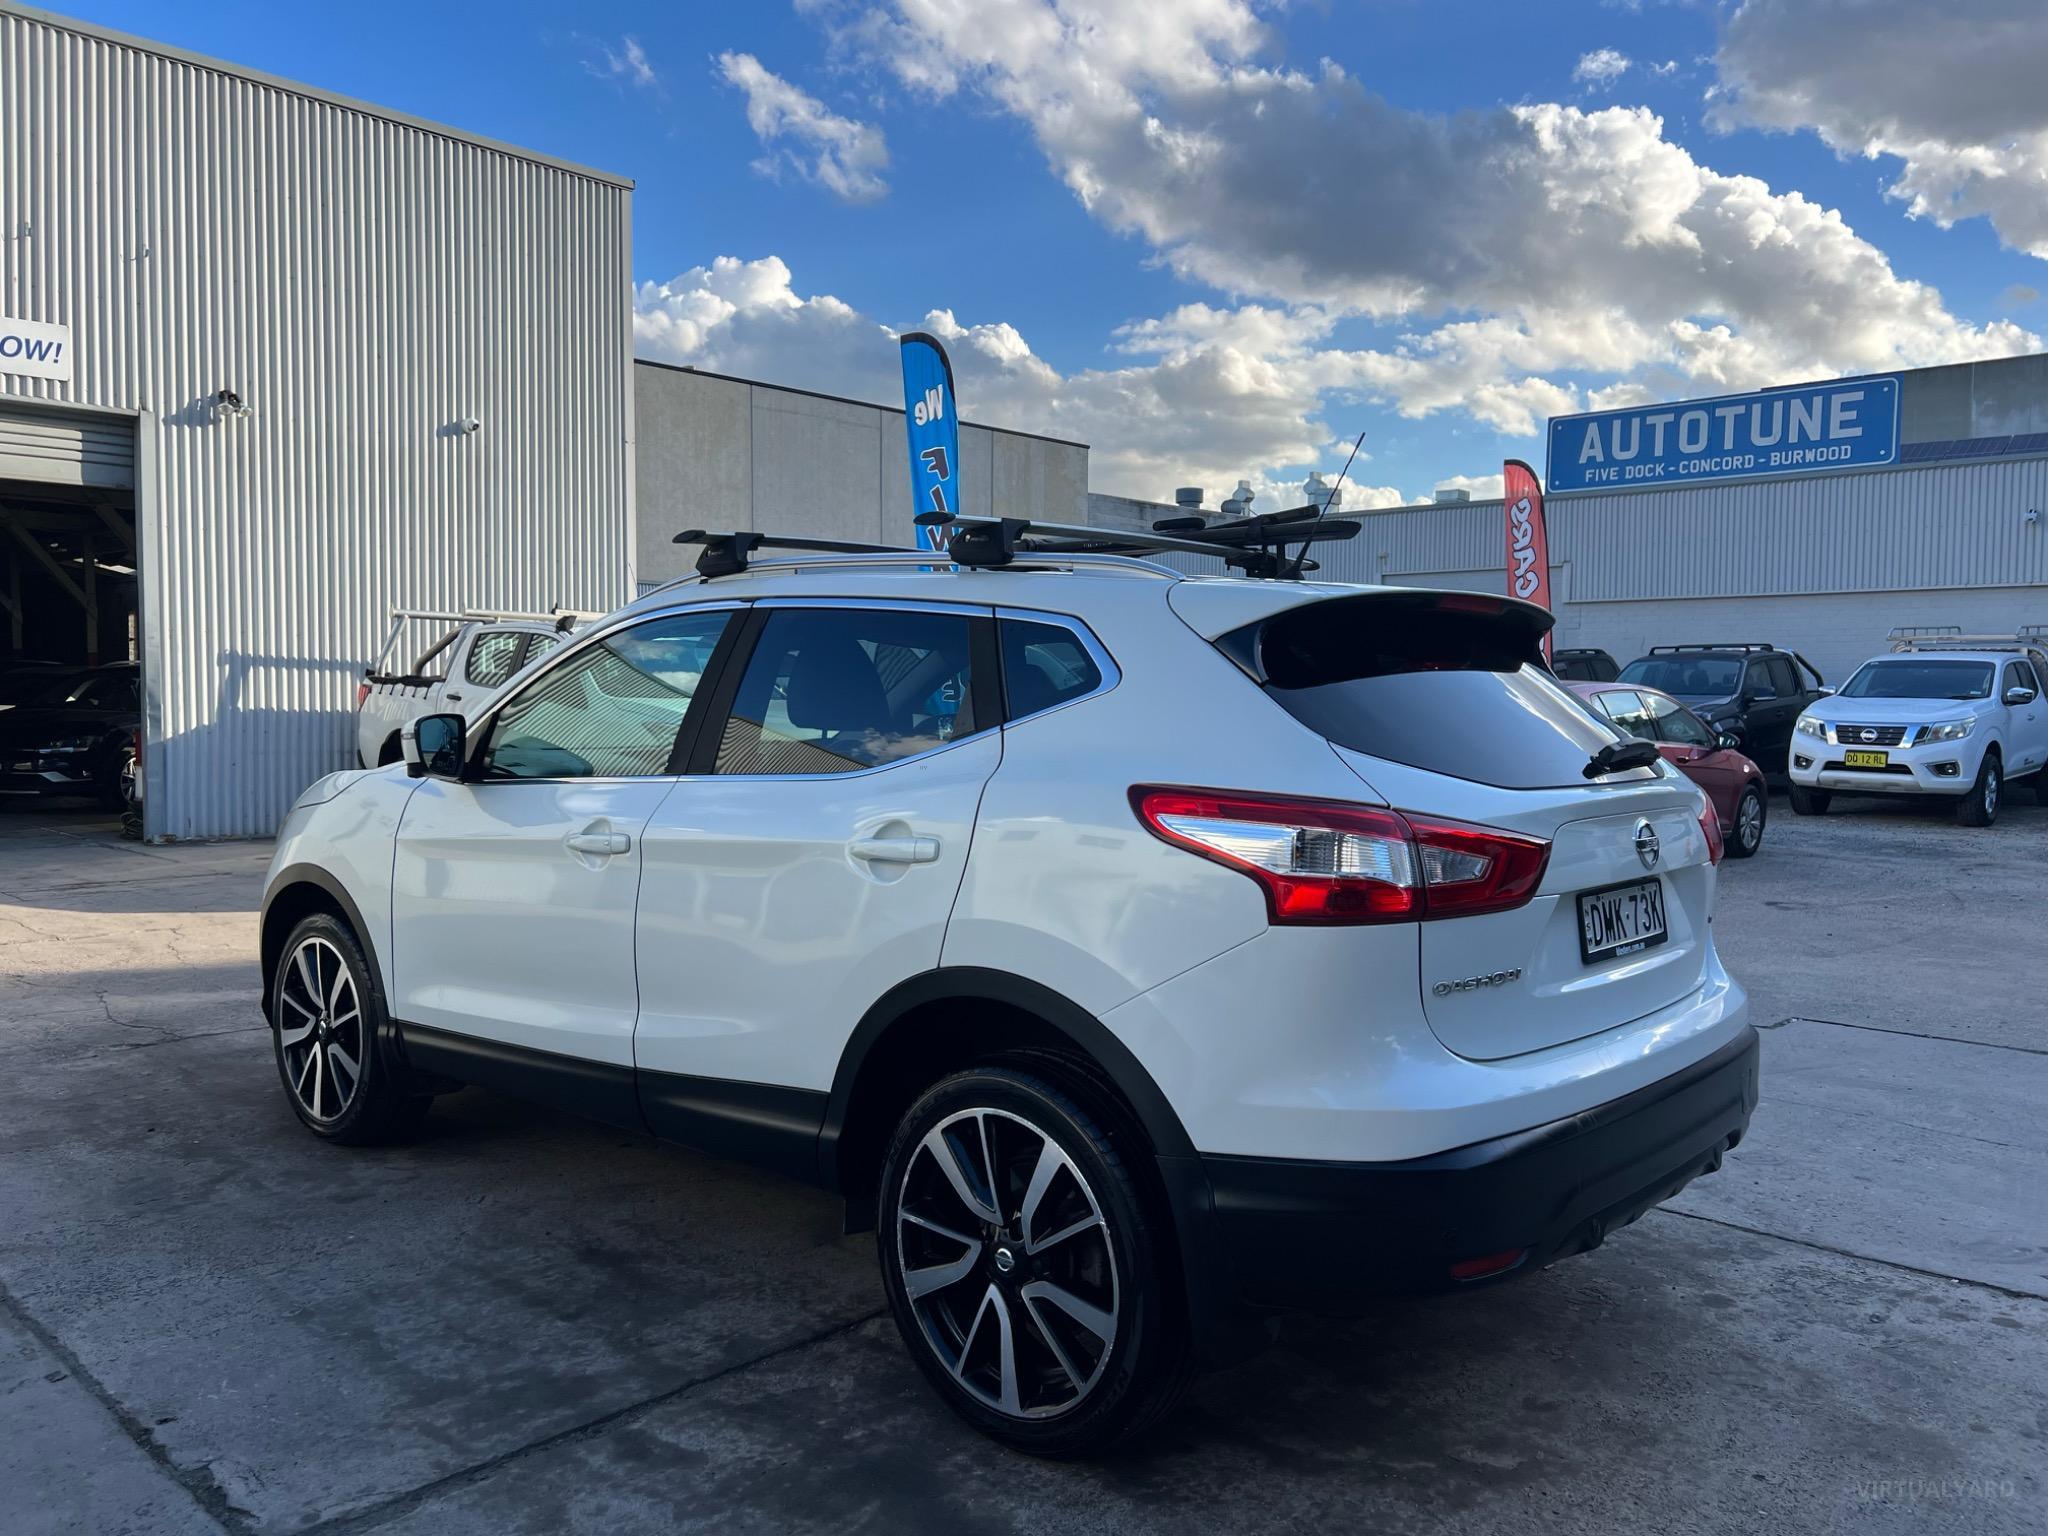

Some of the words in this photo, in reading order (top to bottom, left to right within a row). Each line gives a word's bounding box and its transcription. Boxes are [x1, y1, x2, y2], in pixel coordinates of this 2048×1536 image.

[0, 335, 62, 363] OW!
[1579, 391, 1864, 464] AUTOTUNE
[1586, 467, 1619, 482] FIVE
[1625, 463, 1665, 479] DOCK
[1679, 455, 1754, 474] CONCORD
[1770, 445, 1851, 466] BURWOOD
[1861, 755, 1871, 764] 12
